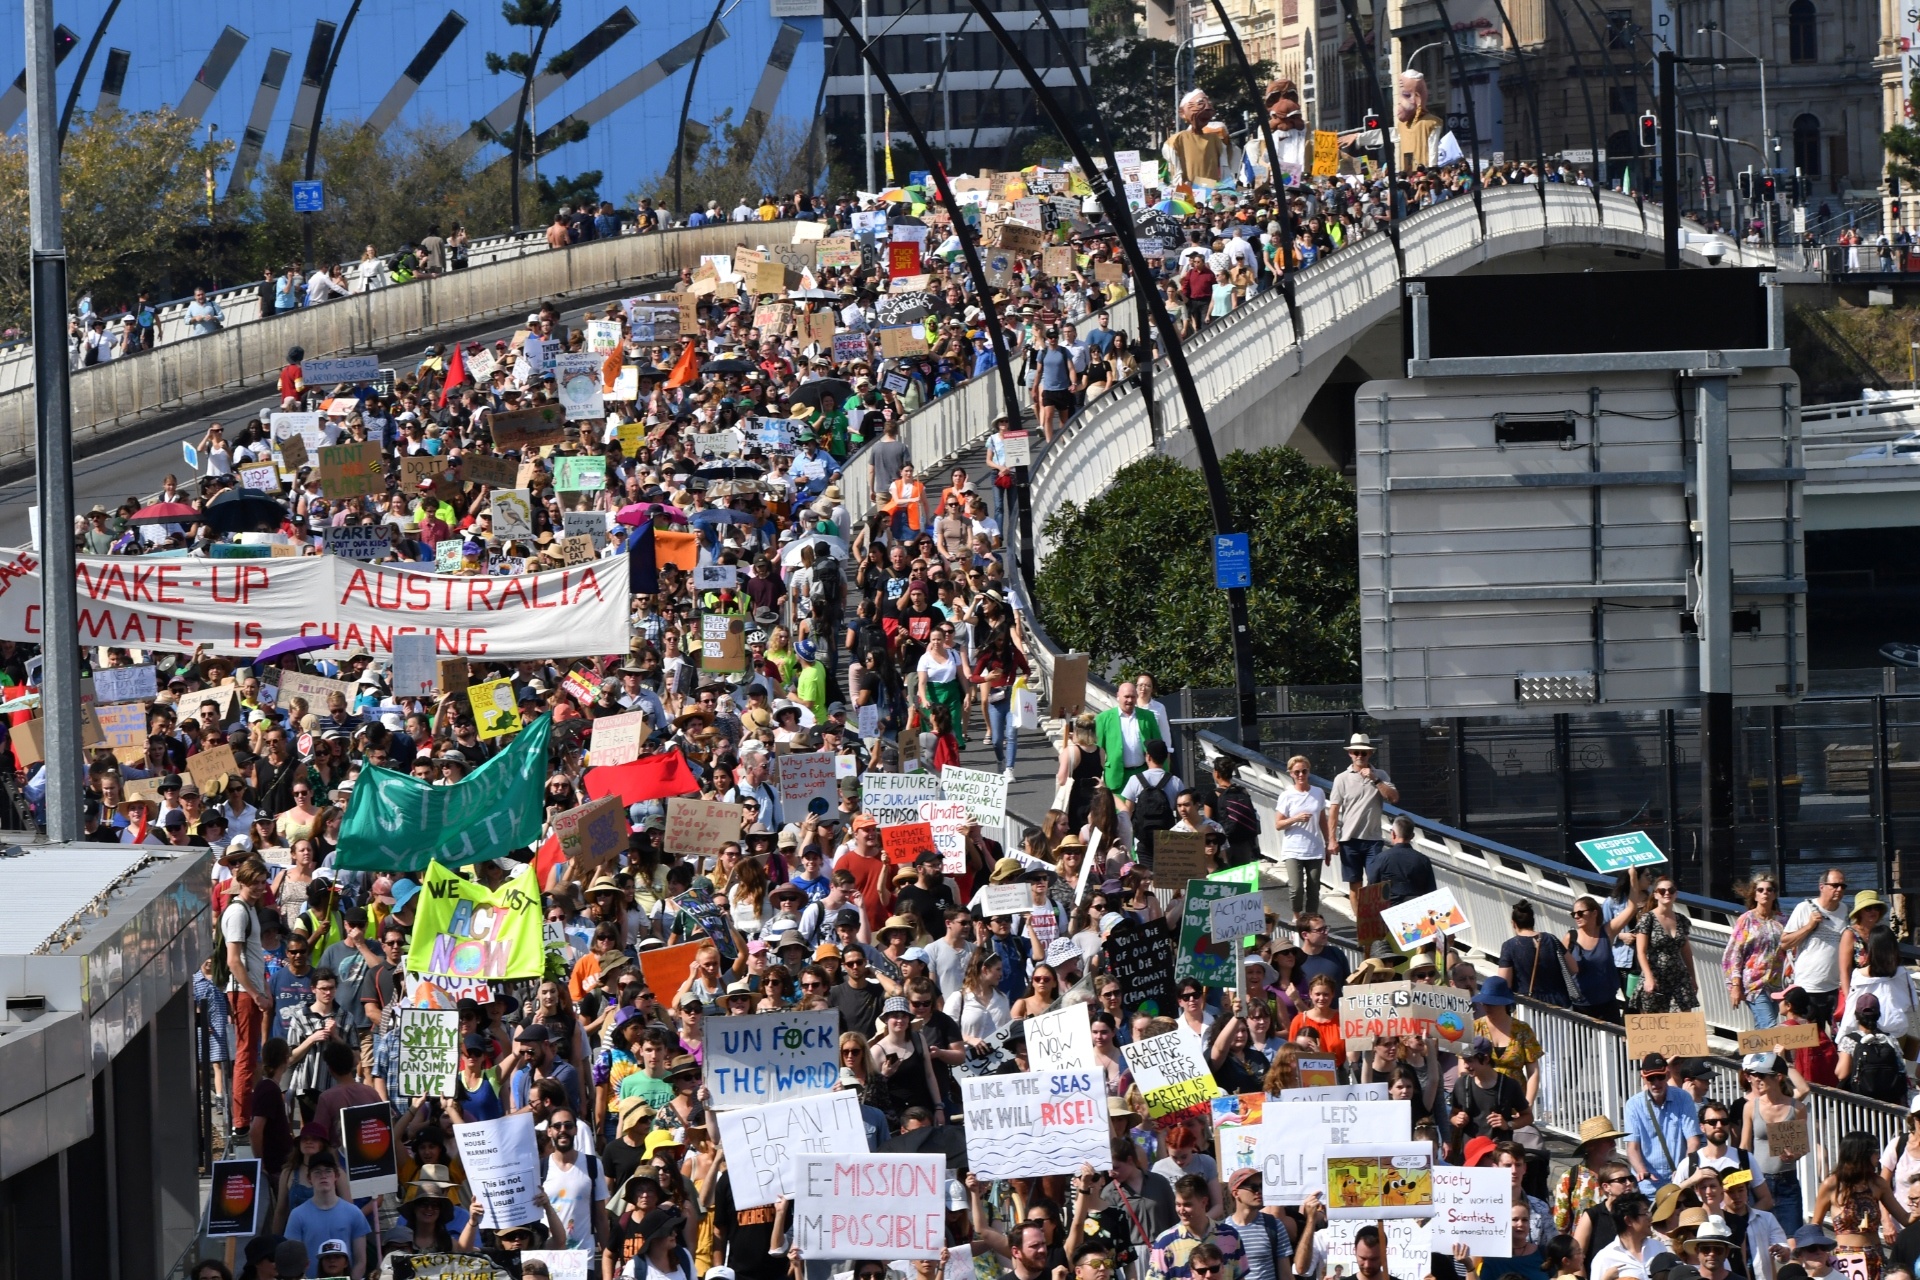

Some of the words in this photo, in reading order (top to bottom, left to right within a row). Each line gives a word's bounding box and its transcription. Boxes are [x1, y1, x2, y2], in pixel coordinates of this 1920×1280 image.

[893, 248, 913, 256] FUCK
[884, 291, 929, 309] CLIMATE
[887, 298, 933, 324] EMERGENCY
[542, 343, 559, 352] THERE
[304, 361, 331, 371] STOP
[335, 359, 375, 369] GLOBAL
[303, 369, 379, 383] WARMONGERING
[765, 420, 786, 431] ICE
[696, 434, 729, 443] CLIMATE
[324, 445, 363, 465] AINT
[408, 461, 427, 475] DO
[430, 460, 443, 473] IT
[244, 469, 268, 483] STOP
[323, 475, 373, 494] PLANET
[333, 526, 373, 540] CARE
[564, 543, 586, 553] CANT
[1218, 550, 1246, 558] CitySafe
[569, 551, 583, 560] EAT
[341, 567, 605, 610] AUSTRALIA
[25, 605, 194, 647] CMATE
[234, 622, 262, 648] IS
[704, 615, 730, 624] PLANT
[470, 683, 495, 695] CLIMATE
[781, 758, 802, 770] Why
[805, 757, 831, 768] study
[782, 771, 797, 780] for
[809, 769, 835, 779] future
[945, 768, 963, 780] THE
[964, 772, 990, 784] WORLD
[990, 775, 1005, 786] IS
[865, 776, 887, 789] THE
[891, 776, 935, 789] FUTURE
[941, 781, 979, 794] CHANGED
[984, 786, 998, 798] BY
[786, 790, 813, 800] have?
[864, 794, 880, 805] OF
[883, 794, 903, 805] OUR
[967, 796, 1002, 809] EXAMPLE
[677, 804, 697, 816] You
[707, 806, 738, 818] Earn
[920, 803, 965, 821] Climate
[671, 816, 708, 830] Today
[672, 829, 690, 837] we
[699, 831, 720, 841] pay
[890, 828, 925, 838] CLIMATE
[886, 836, 931, 846] EMERGENCY
[1593, 835, 1640, 851] RESPECT
[894, 848, 906, 858] ON
[1606, 845, 1637, 857] YOUR
[428, 880, 460, 899] WE
[1215, 901, 1237, 916] ACT
[1241, 899, 1262, 911] NOW
[448, 898, 509, 941] ACT
[1234, 914, 1246, 923] OR
[428, 932, 514, 978] NOW
[1116, 951, 1127, 961] OF
[1133, 946, 1148, 957] OLD
[1158, 950, 1168, 960] OF
[1346, 993, 1390, 1010] THERE
[1394, 990, 1410, 1004] IS
[1412, 991, 1427, 1005] NO
[1429, 993, 1474, 1013] ECONOMY
[411, 1012, 443, 1027] LIVE
[1364, 1007, 1381, 1018] ON
[1388, 1007, 1398, 1018] A
[1029, 1011, 1067, 1041] ACT
[1345, 1019, 1384, 1038] DEAD
[1386, 1018, 1436, 1038] PLANET
[1631, 1016, 1670, 1031] SCIENCE
[403, 1026, 457, 1047] SIMPLY
[722, 1029, 761, 1053] UN
[1632, 1034, 1656, 1044] care
[1667, 1034, 1694, 1043] about
[1742, 1036, 1781, 1049] PLAN-IT
[1039, 1033, 1073, 1058] NOW
[1125, 1032, 1182, 1060] GLACIERS
[408, 1049, 427, 1062] SO
[432, 1048, 447, 1061] WE
[1051, 1053, 1063, 1062] OR
[401, 1062, 422, 1072] CAN
[423, 1062, 456, 1073] SIMPLY
[1161, 1056, 1195, 1076] REEFS
[405, 1074, 445, 1095] LIVE
[714, 1066, 765, 1094] THE
[970, 1082, 1004, 1101] LIKE
[1012, 1078, 1040, 1095] THE
[1050, 1074, 1091, 1095] SEAS
[1144, 1086, 1184, 1108] EARTH
[1195, 1078, 1205, 1090] IS
[742, 1105, 823, 1144] PLAN
[832, 1096, 857, 1131] IT
[968, 1109, 997, 1131] WE
[999, 1106, 1032, 1128] WILL
[1041, 1100, 1093, 1126] RISE!
[1156, 1114, 1174, 1129] SO
[1321, 1105, 1358, 1124] LET'S
[1778, 1122, 1795, 1132] OUR
[1332, 1128, 1349, 1143] BE
[1771, 1132, 1802, 1141] PLANET
[466, 1148, 498, 1156] WARMING
[751, 1143, 789, 1168] FOR
[802, 1136, 832, 1153] THE
[507, 1176, 522, 1184] not
[808, 1163, 937, 1198] E-MISSION
[482, 1189, 514, 1197] business
[1453, 1194, 1463, 1204] be
[1470, 1194, 1503, 1205] worried
[493, 1197, 515, 1207] usual
[1448, 1208, 1496, 1224] Scientists
[797, 1214, 940, 1250] IM-POSSIBLE
[1330, 1225, 1347, 1239] Is
[1439, 1226, 1445, 1236] to
[1451, 1221, 1508, 1238] demonstrate!
[1402, 1242, 1428, 1266] Young
[411, 1257, 490, 1271] PROTECT
